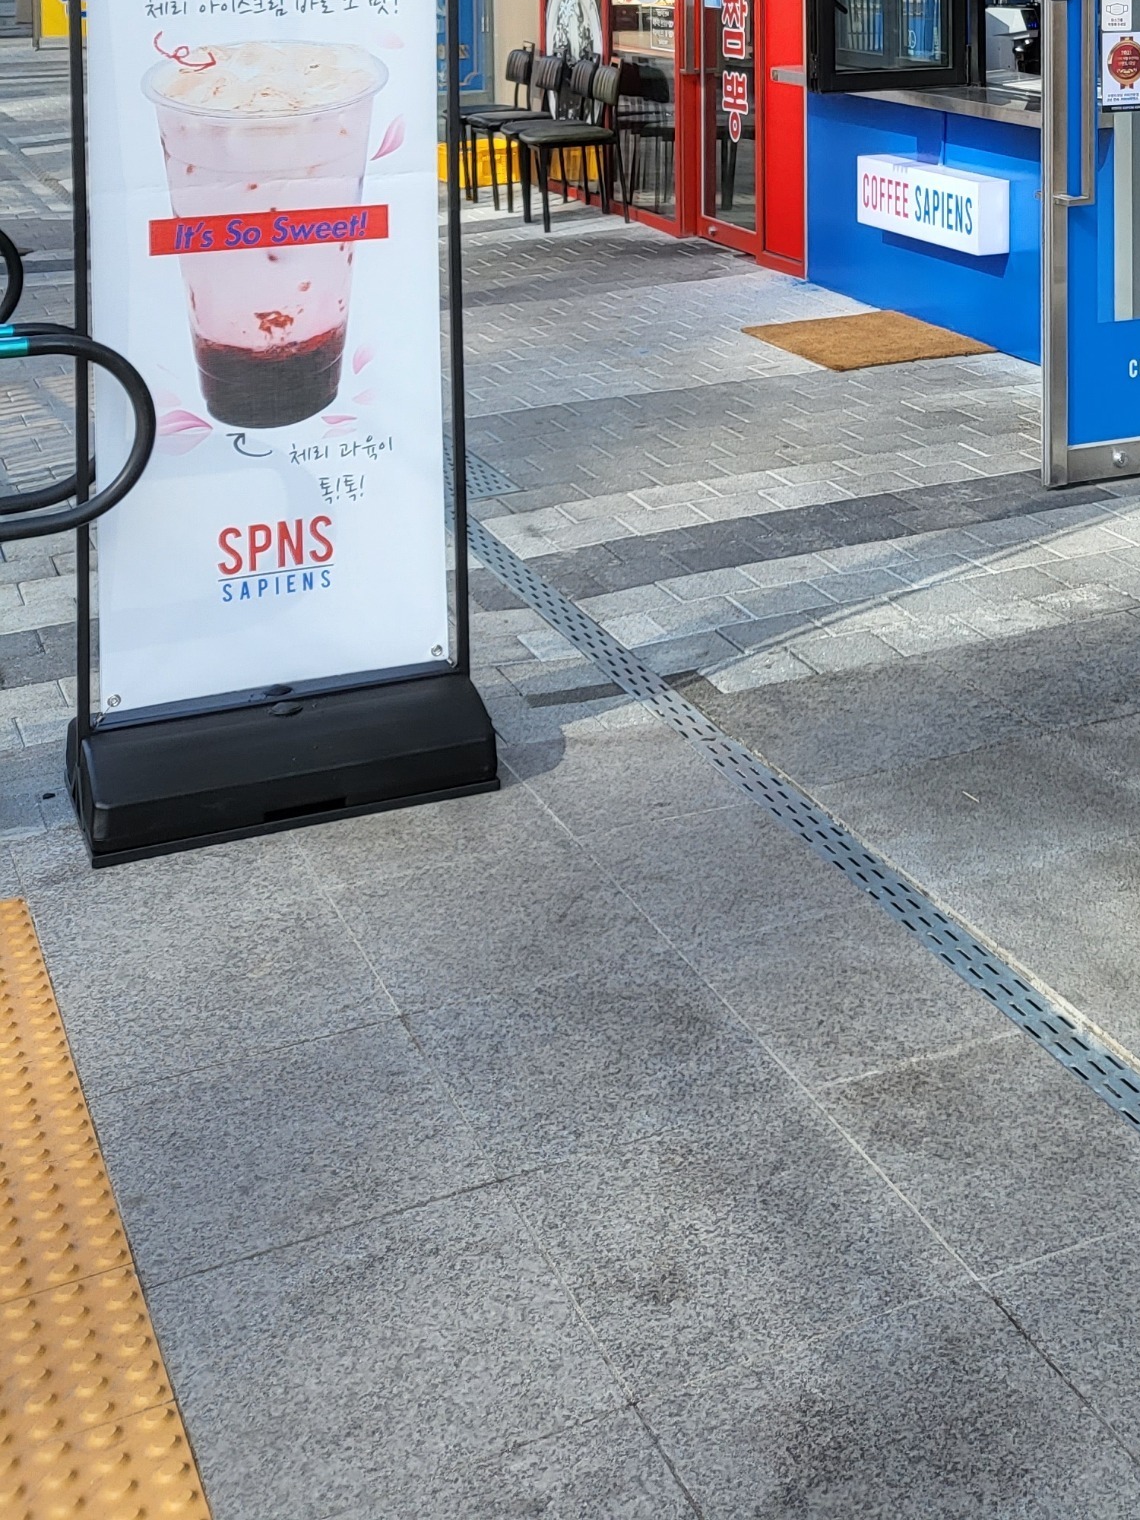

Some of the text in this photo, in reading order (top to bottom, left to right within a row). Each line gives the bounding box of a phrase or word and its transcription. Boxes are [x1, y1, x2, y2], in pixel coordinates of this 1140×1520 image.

[863, 173, 973, 235] COFFEE SAPIENS
[174, 211, 368, 250] It's So Sweet!
[289, 435, 393, 465] 체리 과육이
[217, 515, 334, 575] SPNS
[222, 569, 331, 602] SAPIENS
